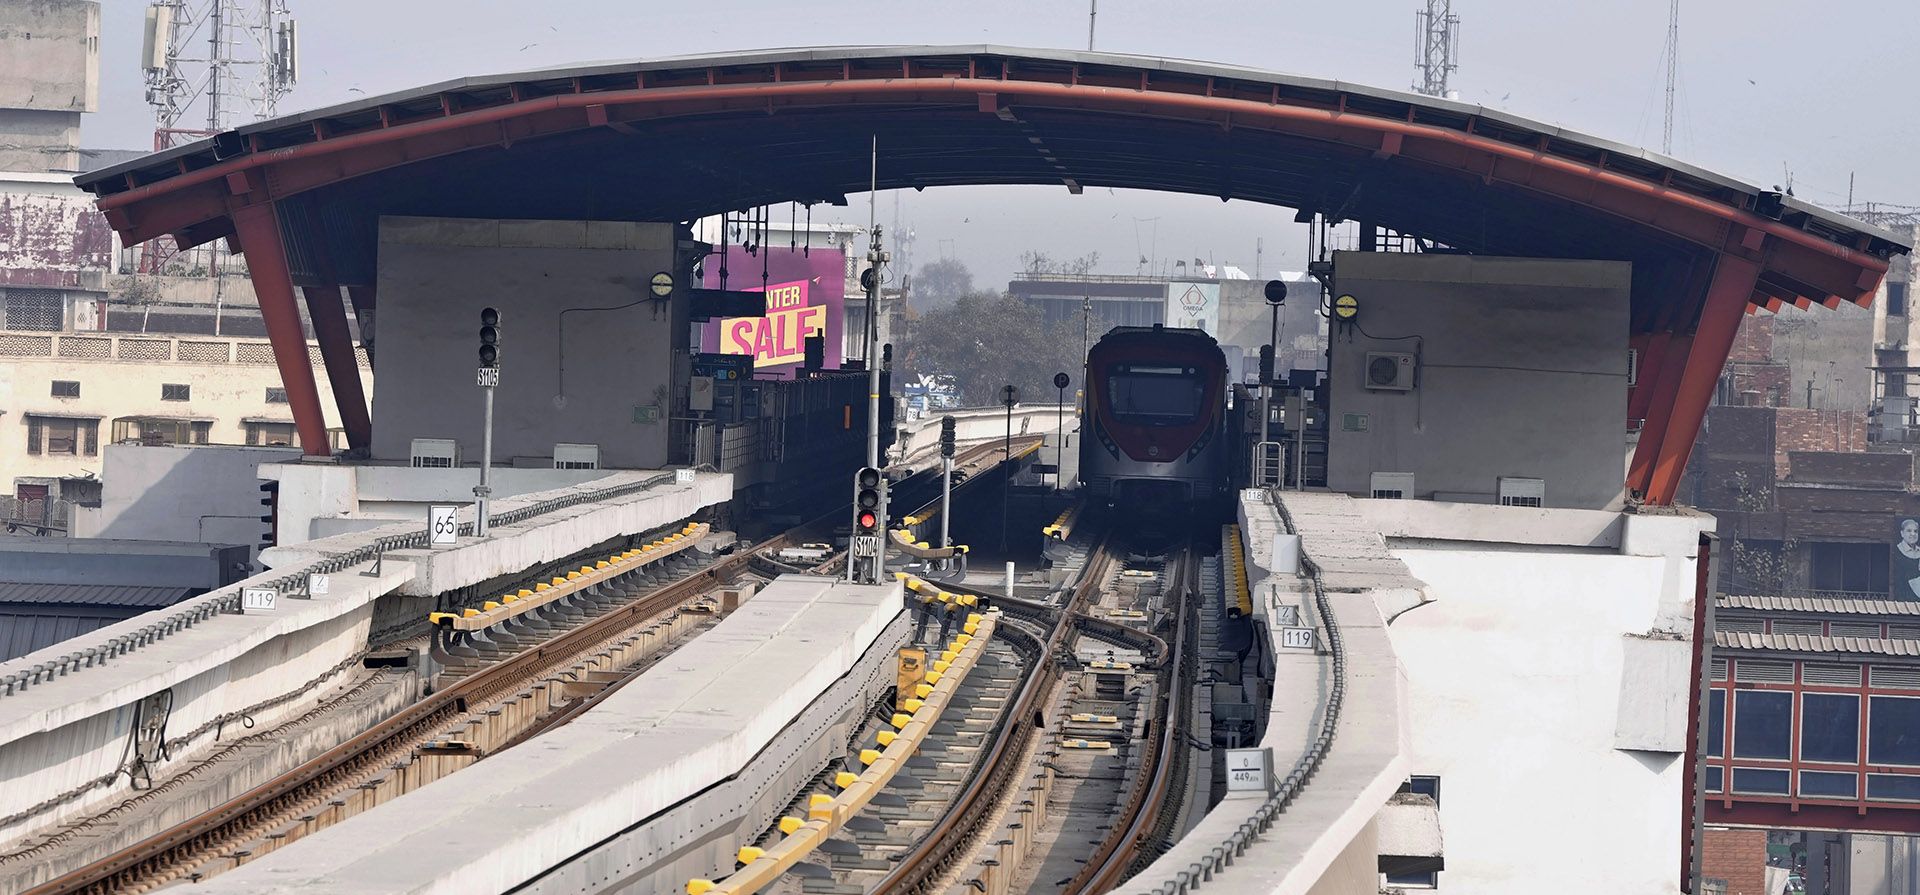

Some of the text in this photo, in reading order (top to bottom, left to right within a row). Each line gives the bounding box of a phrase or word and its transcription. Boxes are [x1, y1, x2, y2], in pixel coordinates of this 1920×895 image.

[731, 309, 817, 361] SALE
[478, 368, 498, 385] S1105
[1058, 375, 1067, 386] P
[908, 411, 917, 419] 78
[680, 472, 694, 481] 118
[1247, 491, 1262, 500] 118
[249, 592, 274, 606] 119
[1286, 631, 1311, 645] 119
[1243, 758, 1249, 767] 0
